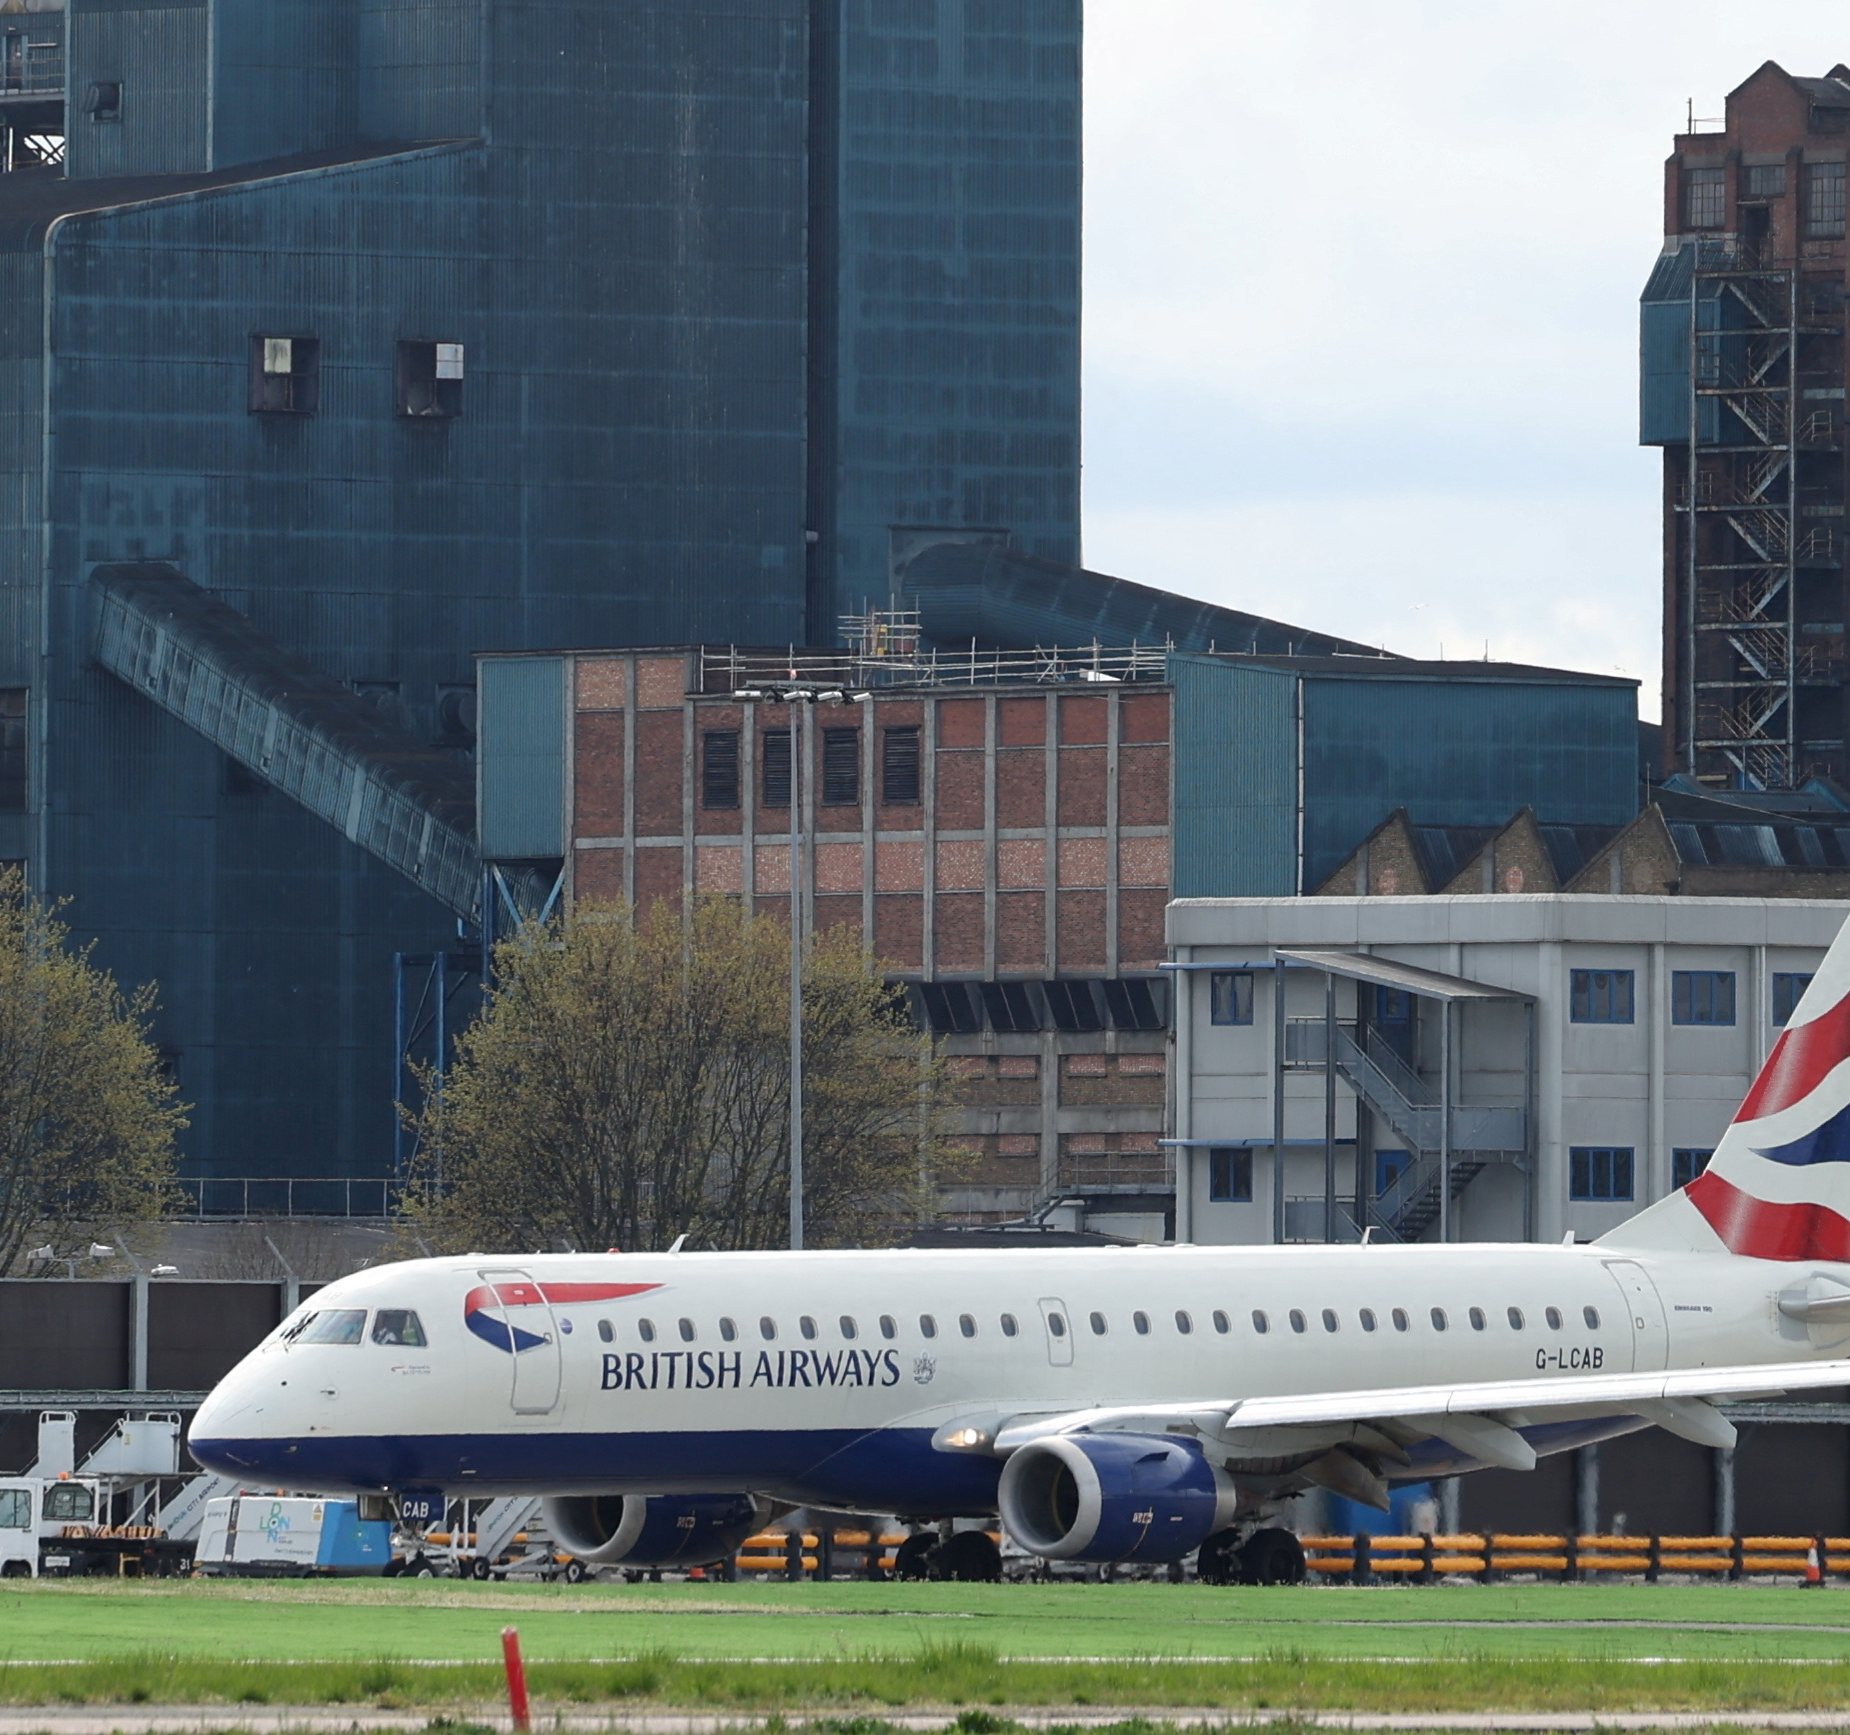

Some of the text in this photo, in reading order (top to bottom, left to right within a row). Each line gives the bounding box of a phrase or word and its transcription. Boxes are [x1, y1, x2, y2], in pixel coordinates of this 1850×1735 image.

[1535, 1347, 1604, 1370] G-LCAB
[601, 1349, 900, 1391] BRITISH AIRWAYS
[402, 1501, 430, 1518] CAB
[180, 1558, 191, 1570] 31
